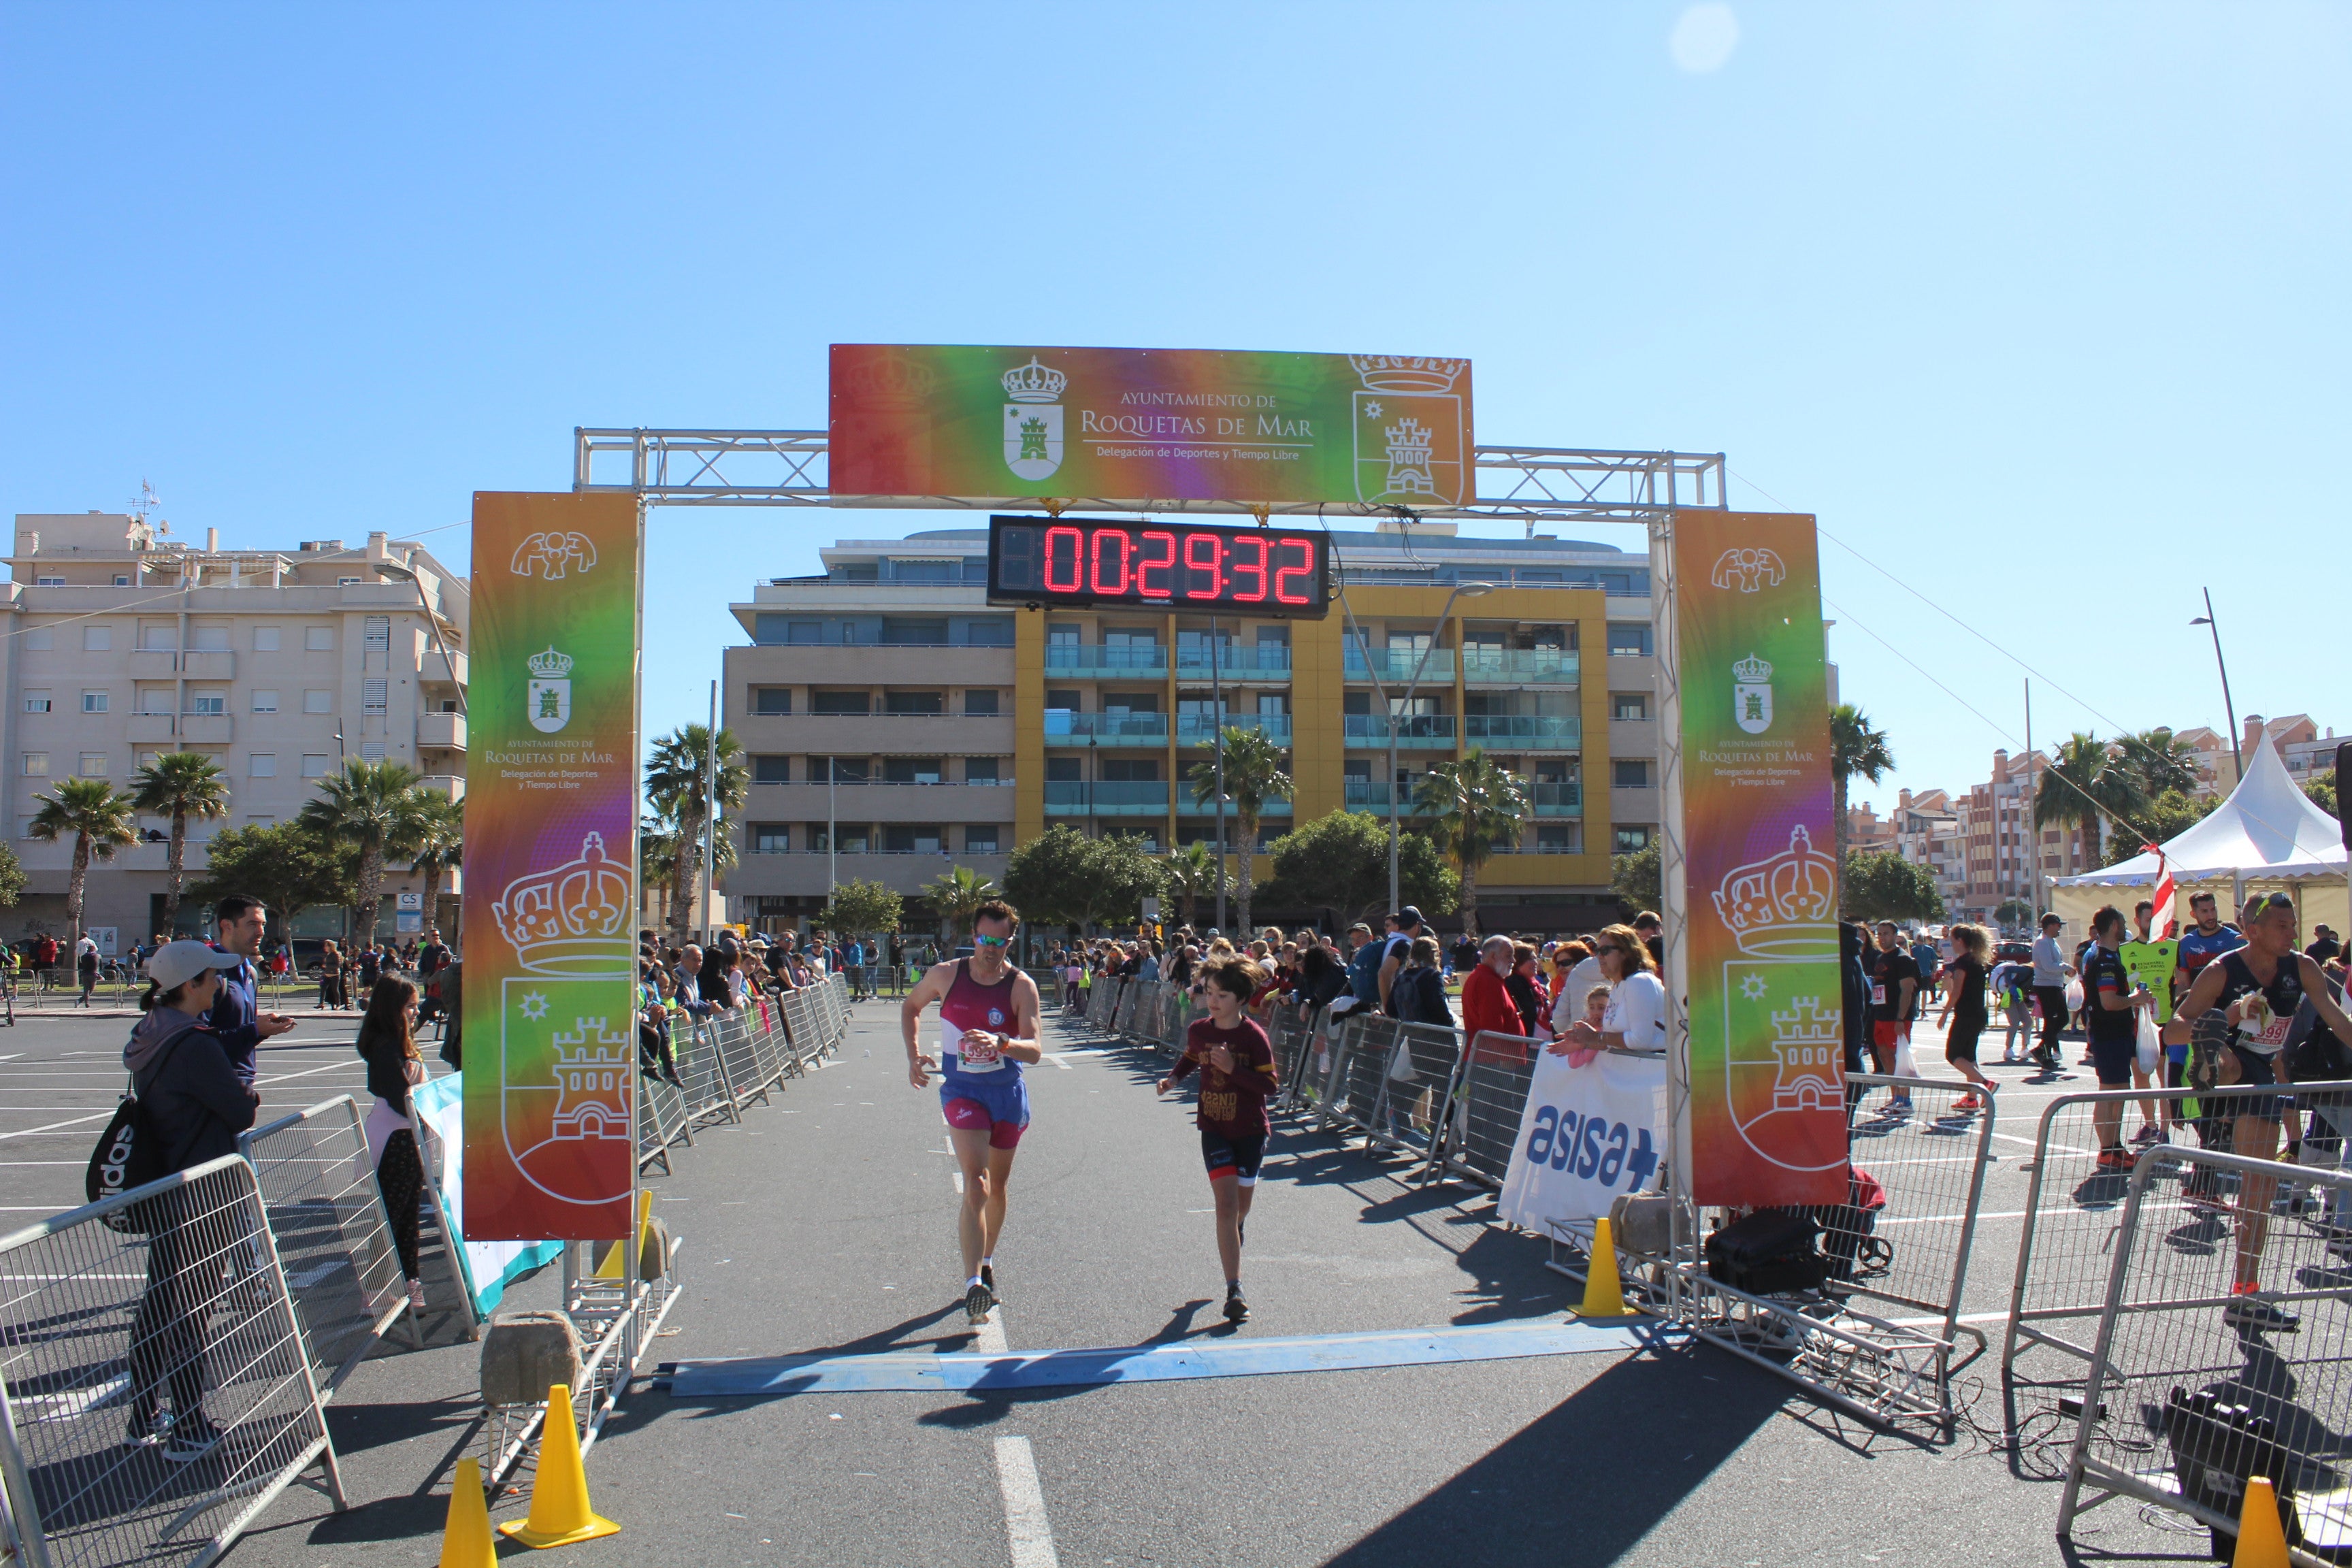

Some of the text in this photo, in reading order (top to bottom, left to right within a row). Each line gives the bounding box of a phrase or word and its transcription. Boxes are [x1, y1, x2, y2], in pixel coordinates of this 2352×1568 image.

[1121, 392, 1276, 408] AYUNTAMIENTO DE
[1218, 418, 1245, 435] DE
[1096, 446, 1299, 461] Delegación de Deportes y Tiempo Libre
[1043, 527, 1313, 604] 00:29:32
[560, 753, 576, 764] DE
[1765, 752, 1780, 762] DE
[501, 770, 545, 779] Delegación
[561, 770, 598, 779] Deportes
[1714, 768, 1754, 777] Delegación
[1768, 768, 1801, 777] Deportes
[525, 781, 556, 790] Tiempo
[1737, 778, 1764, 787] Tiempo
[402, 894, 416, 904] CS
[1526, 1105, 1629, 1187] asisa
